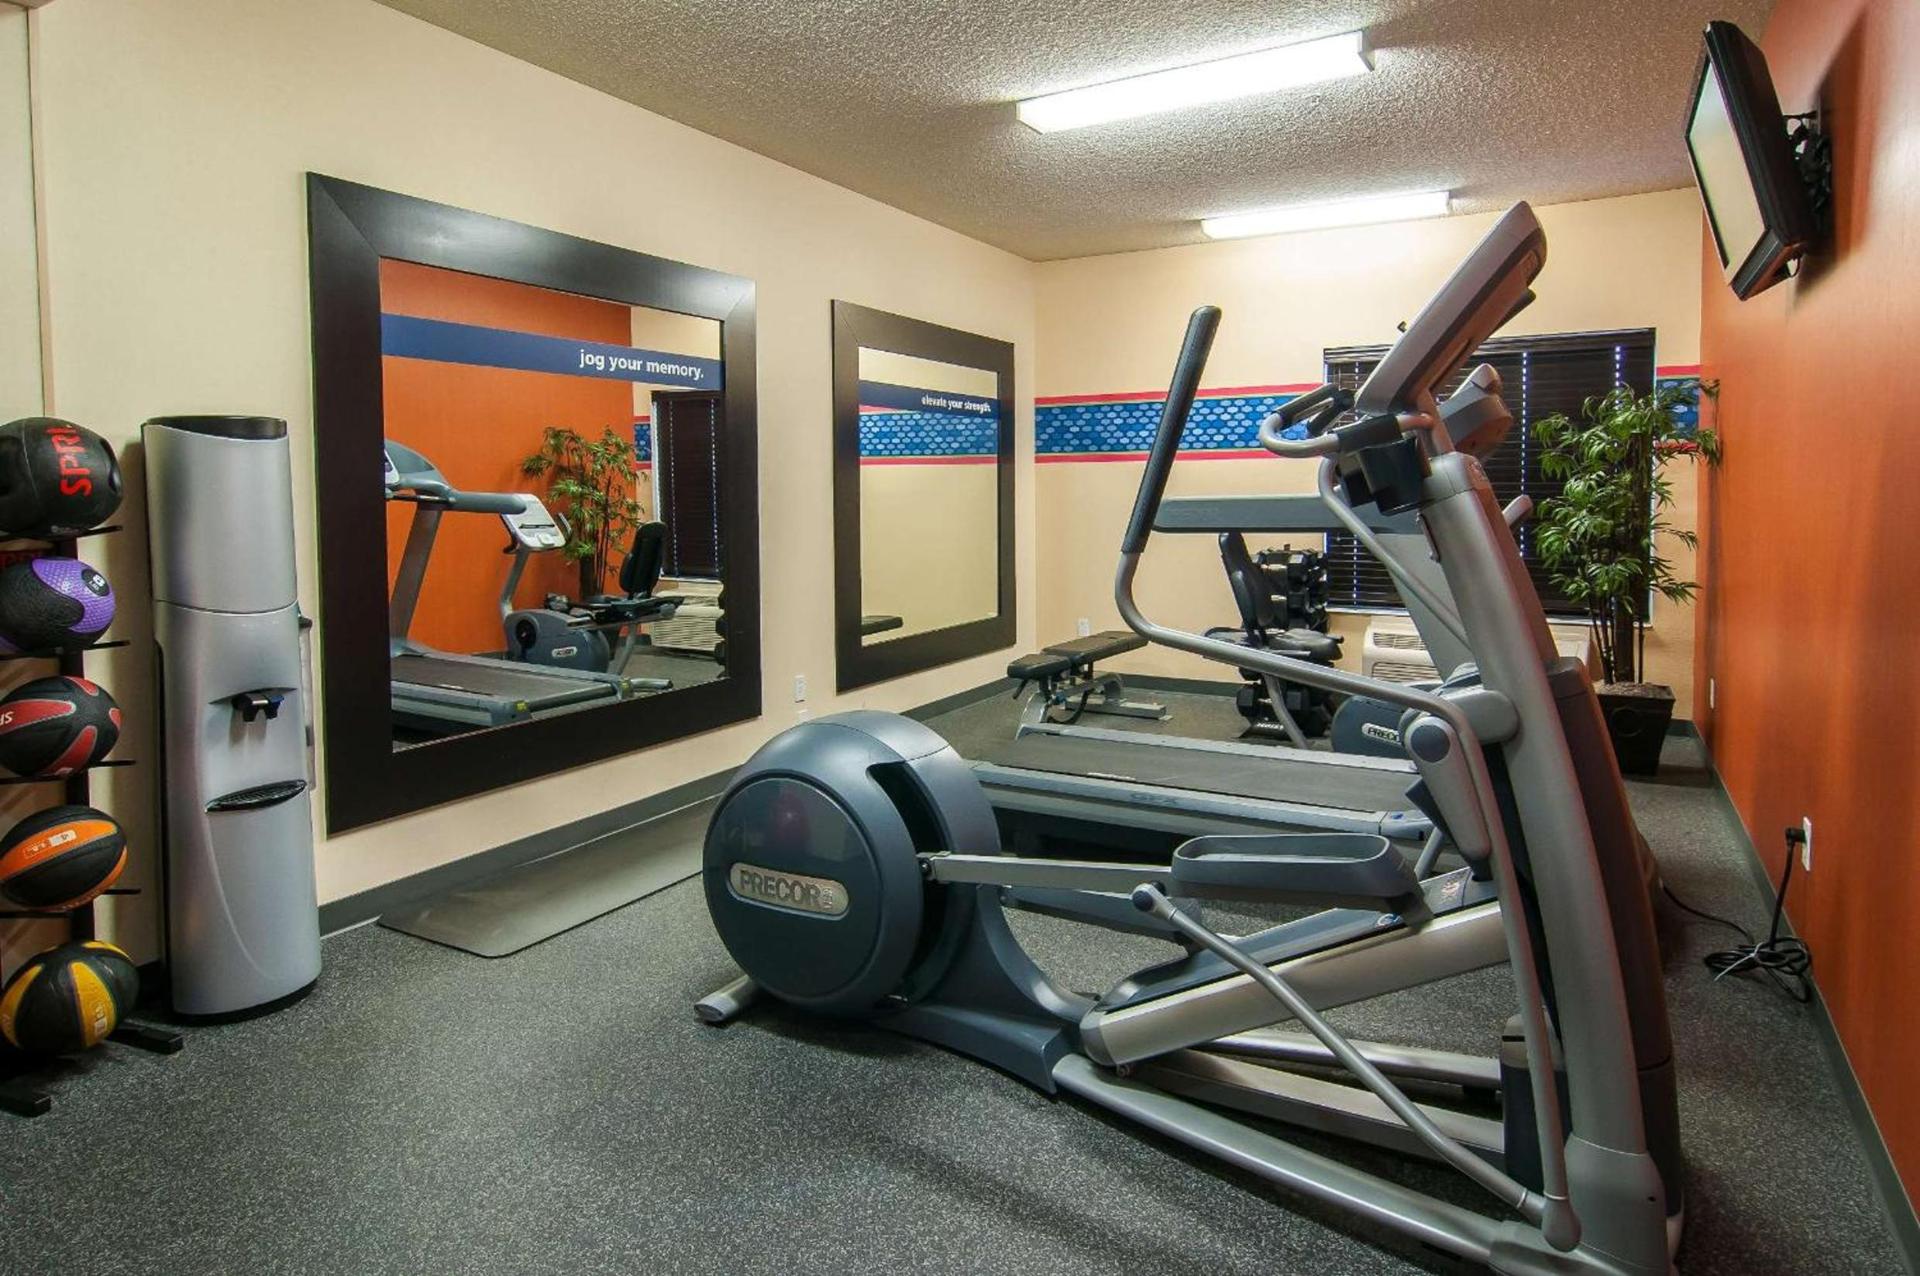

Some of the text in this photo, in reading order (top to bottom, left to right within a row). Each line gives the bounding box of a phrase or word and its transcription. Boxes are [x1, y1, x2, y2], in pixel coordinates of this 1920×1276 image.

[579, 348, 704, 381] jog your memory.
[921, 393, 947, 407] elevate
[947, 400, 963, 411] your
[740, 869, 821, 908] PRECOR
